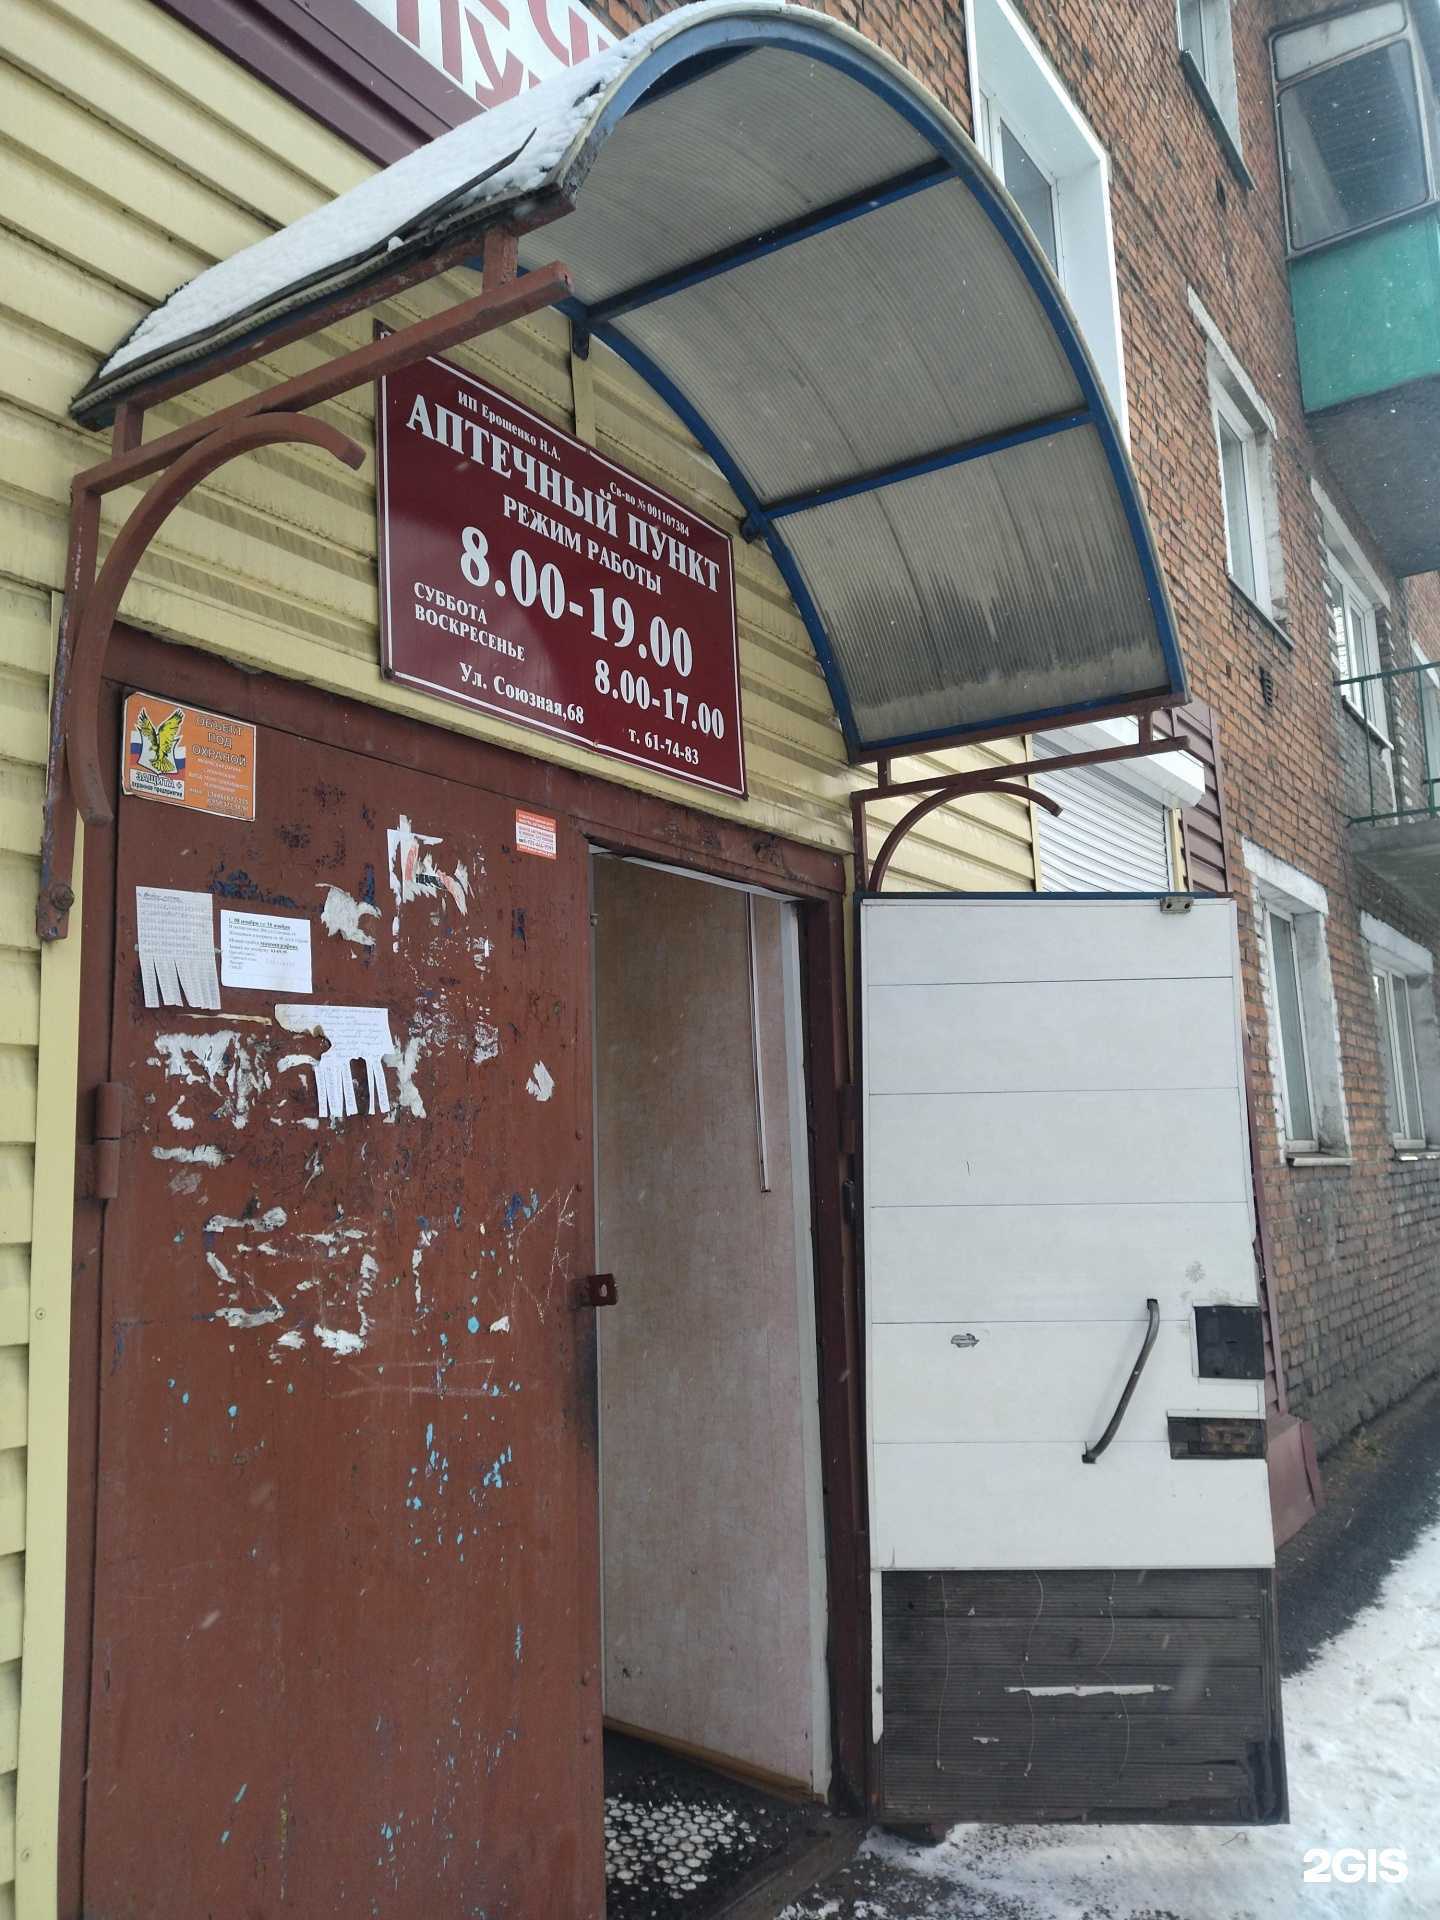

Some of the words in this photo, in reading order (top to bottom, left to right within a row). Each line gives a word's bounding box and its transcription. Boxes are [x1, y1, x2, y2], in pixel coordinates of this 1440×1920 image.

[458, 391, 477, 413] ИП
[481, 403, 536, 446] Ерошенко
[540, 437, 561, 462] Н.А.
[405, 394, 618, 538] АПТЕЧНЫЙ
[628, 512, 720, 593] ПУНКТ
[609, 481, 636, 506] Св-во
[503, 494, 582, 554] РЕЖИМ
[587, 539, 662, 595] РАБОТЫ
[413, 581, 488, 625] СУББОТА
[460, 526, 693, 677] 8.00-19.00
[415, 603, 526, 662] ВОСКРЕСЕНЬЕ
[459, 662, 487, 690] Ул.
[493, 675, 585, 725] Союзная,68
[594, 659, 724, 740] 8.00-17.00
[192, 744, 247, 767] ОХРАНОЙ
[207, 732, 233, 750] ПОД
[628, 728, 640, 745] т.
[644, 731, 699, 765] 61-74-83
